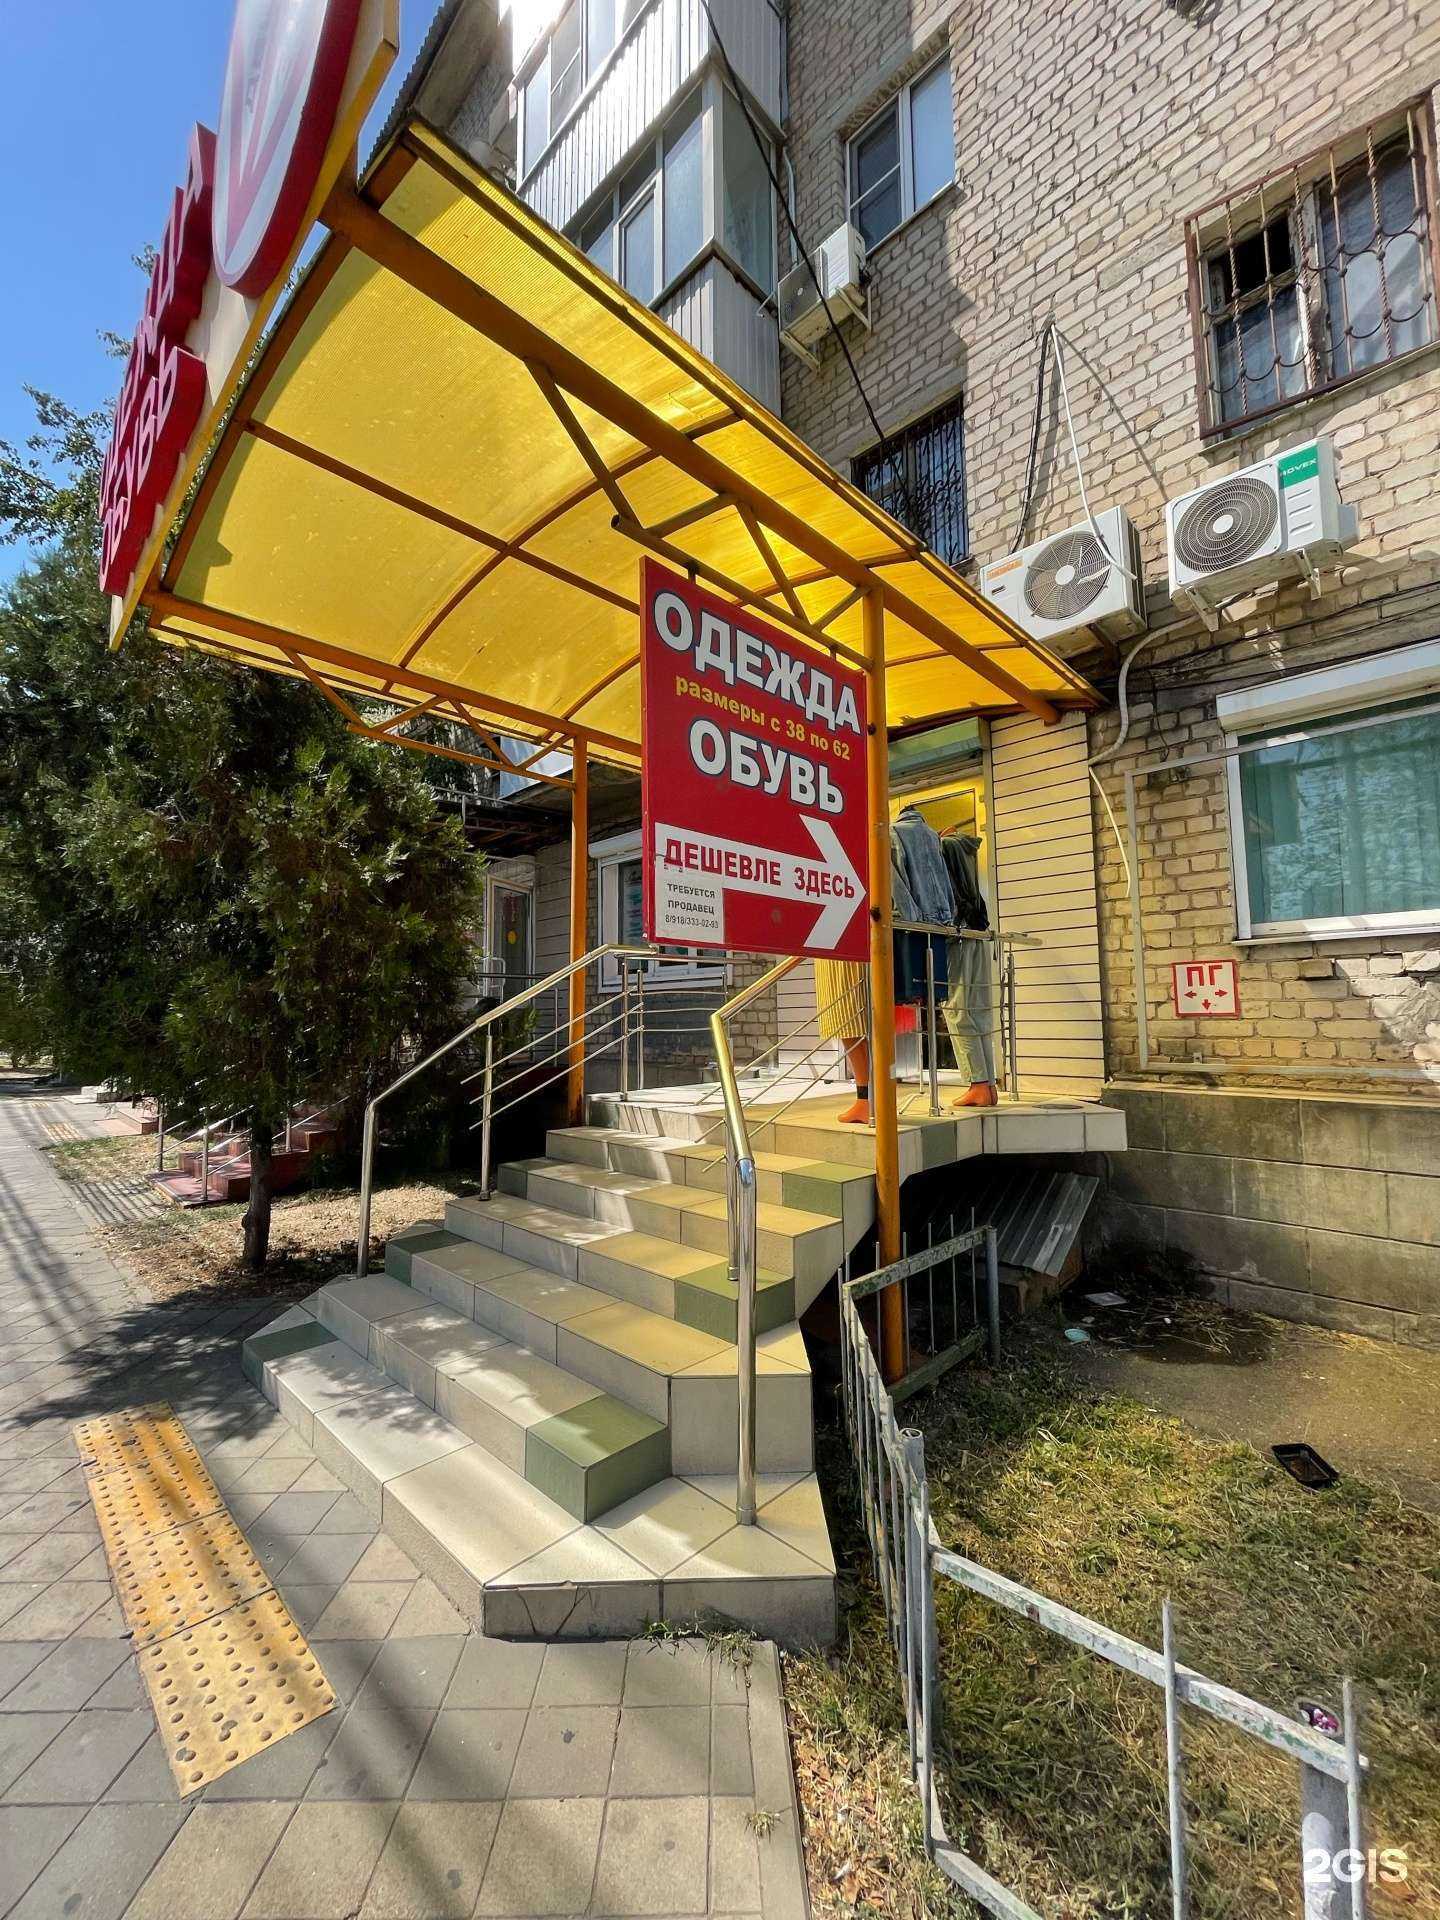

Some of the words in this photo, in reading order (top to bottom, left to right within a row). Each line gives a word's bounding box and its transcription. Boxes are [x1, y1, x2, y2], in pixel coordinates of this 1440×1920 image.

[98, 336, 183, 592] ОБУВЬ
[654, 591, 862, 735] ОДЕЖДА
[675, 675, 765, 727] размеры
[770, 717, 781, 732] с
[786, 719, 806, 742] 38
[811, 731, 829, 751] по
[832, 740, 851, 760] 62
[689, 718, 845, 814] ОБУВЬ
[664, 838, 781, 886] ДЕШЕВЛЕ
[794, 866, 856, 899] ЗДЕСЬ
[666, 883, 716, 899] ТРЕБУЕТСЯ
[668, 900, 715, 916] ПРОДАВЕЦ
[1186, 964, 1223, 987] ПГ
